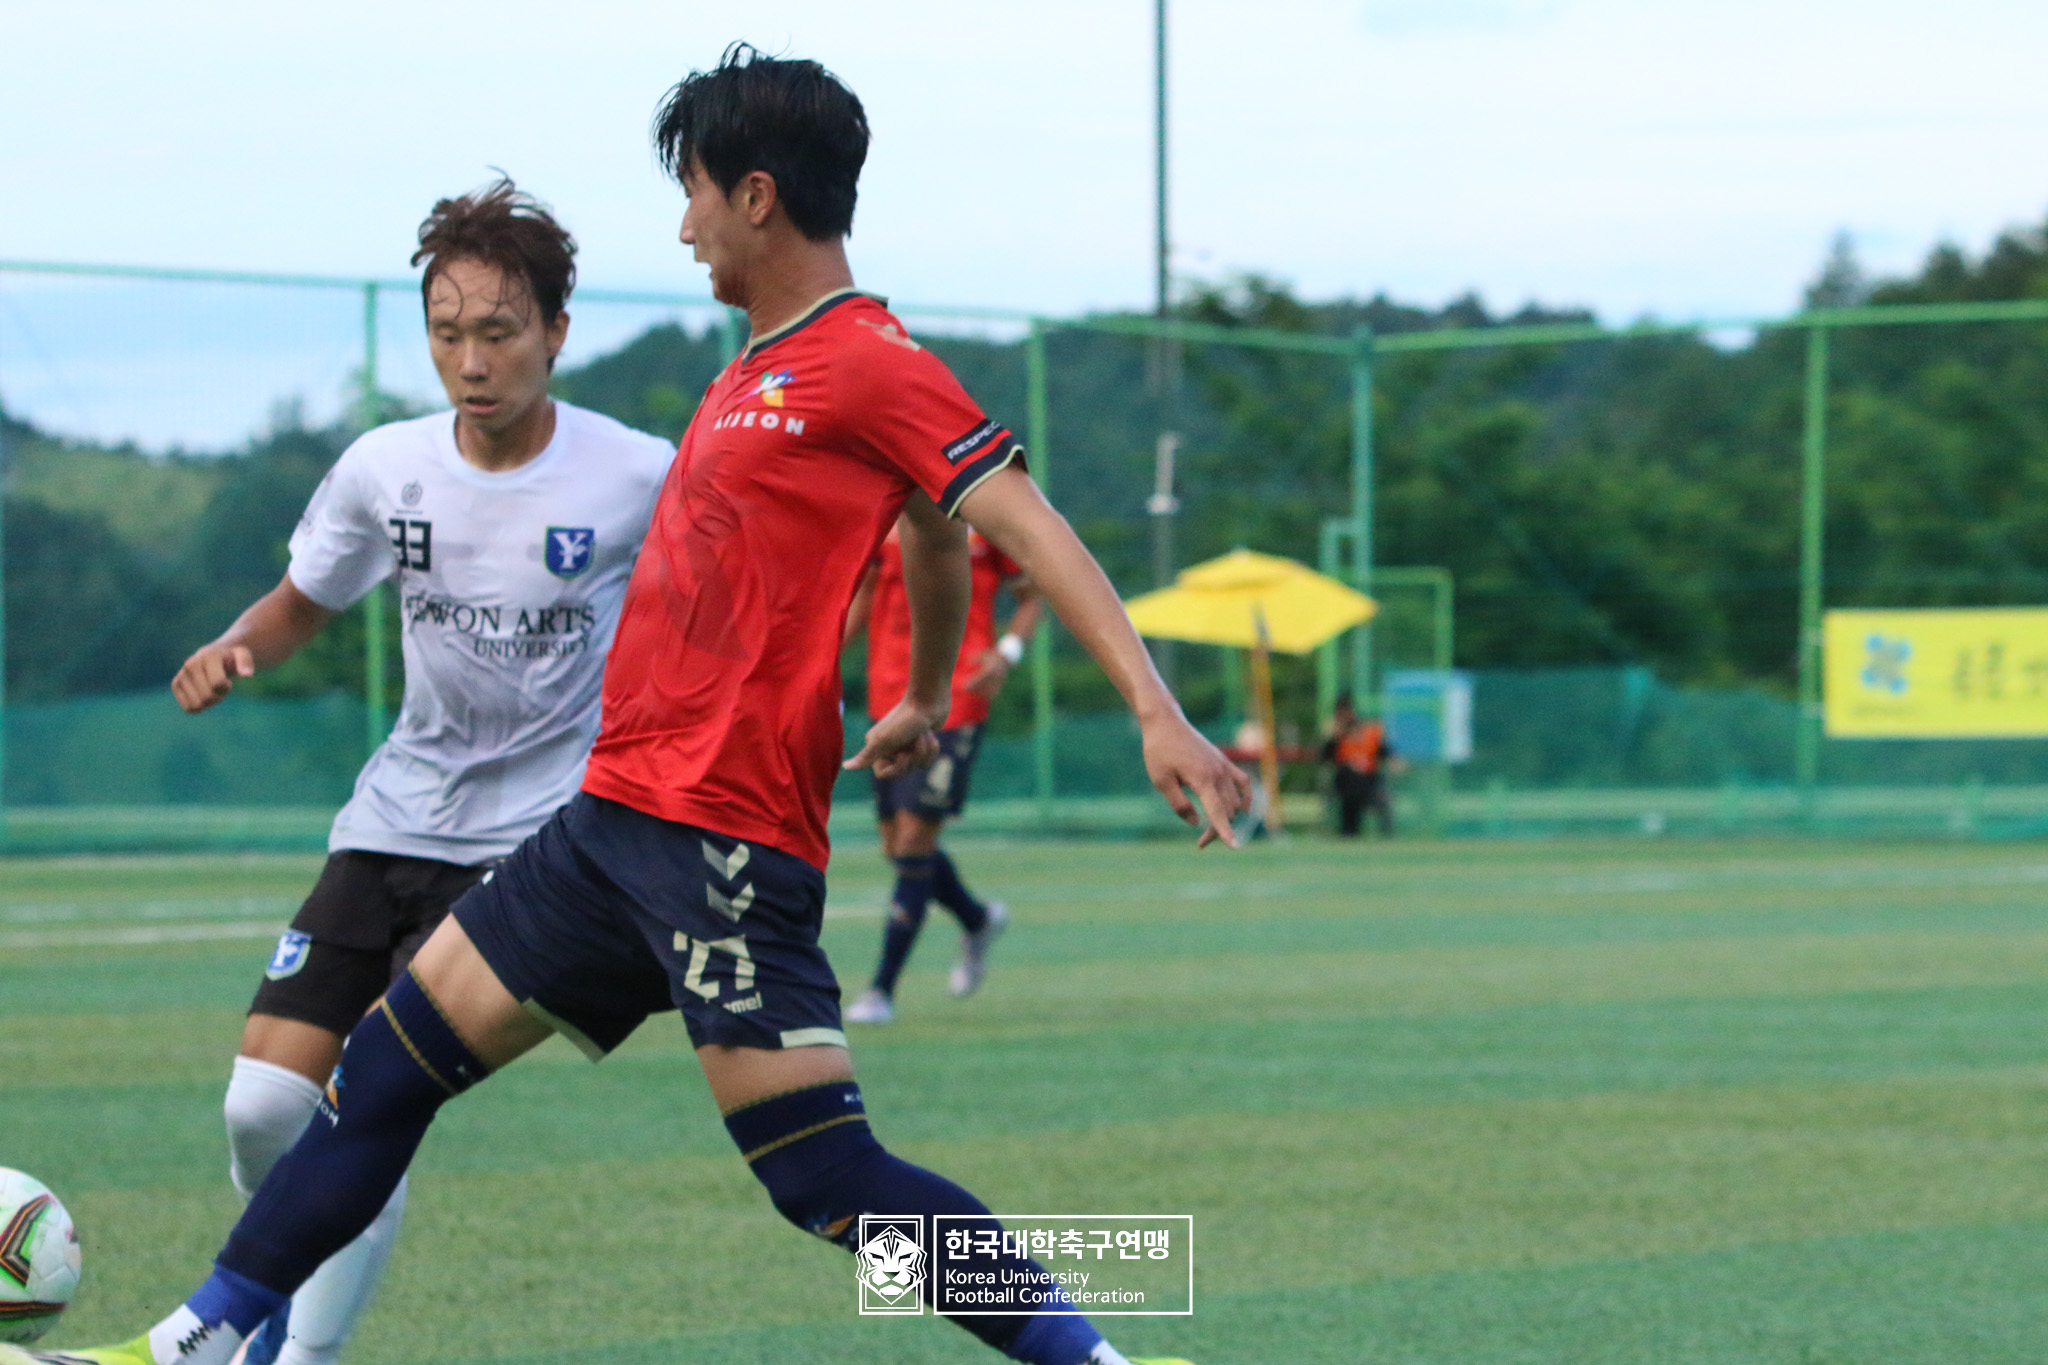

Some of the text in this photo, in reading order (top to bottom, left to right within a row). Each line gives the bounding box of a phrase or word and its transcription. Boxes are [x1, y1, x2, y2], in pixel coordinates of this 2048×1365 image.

[388, 518, 432, 572] 33
[514, 604, 596, 635] ARTS
[473, 635, 589, 658] UNIVERSITY
[673, 930, 756, 1003] 27
